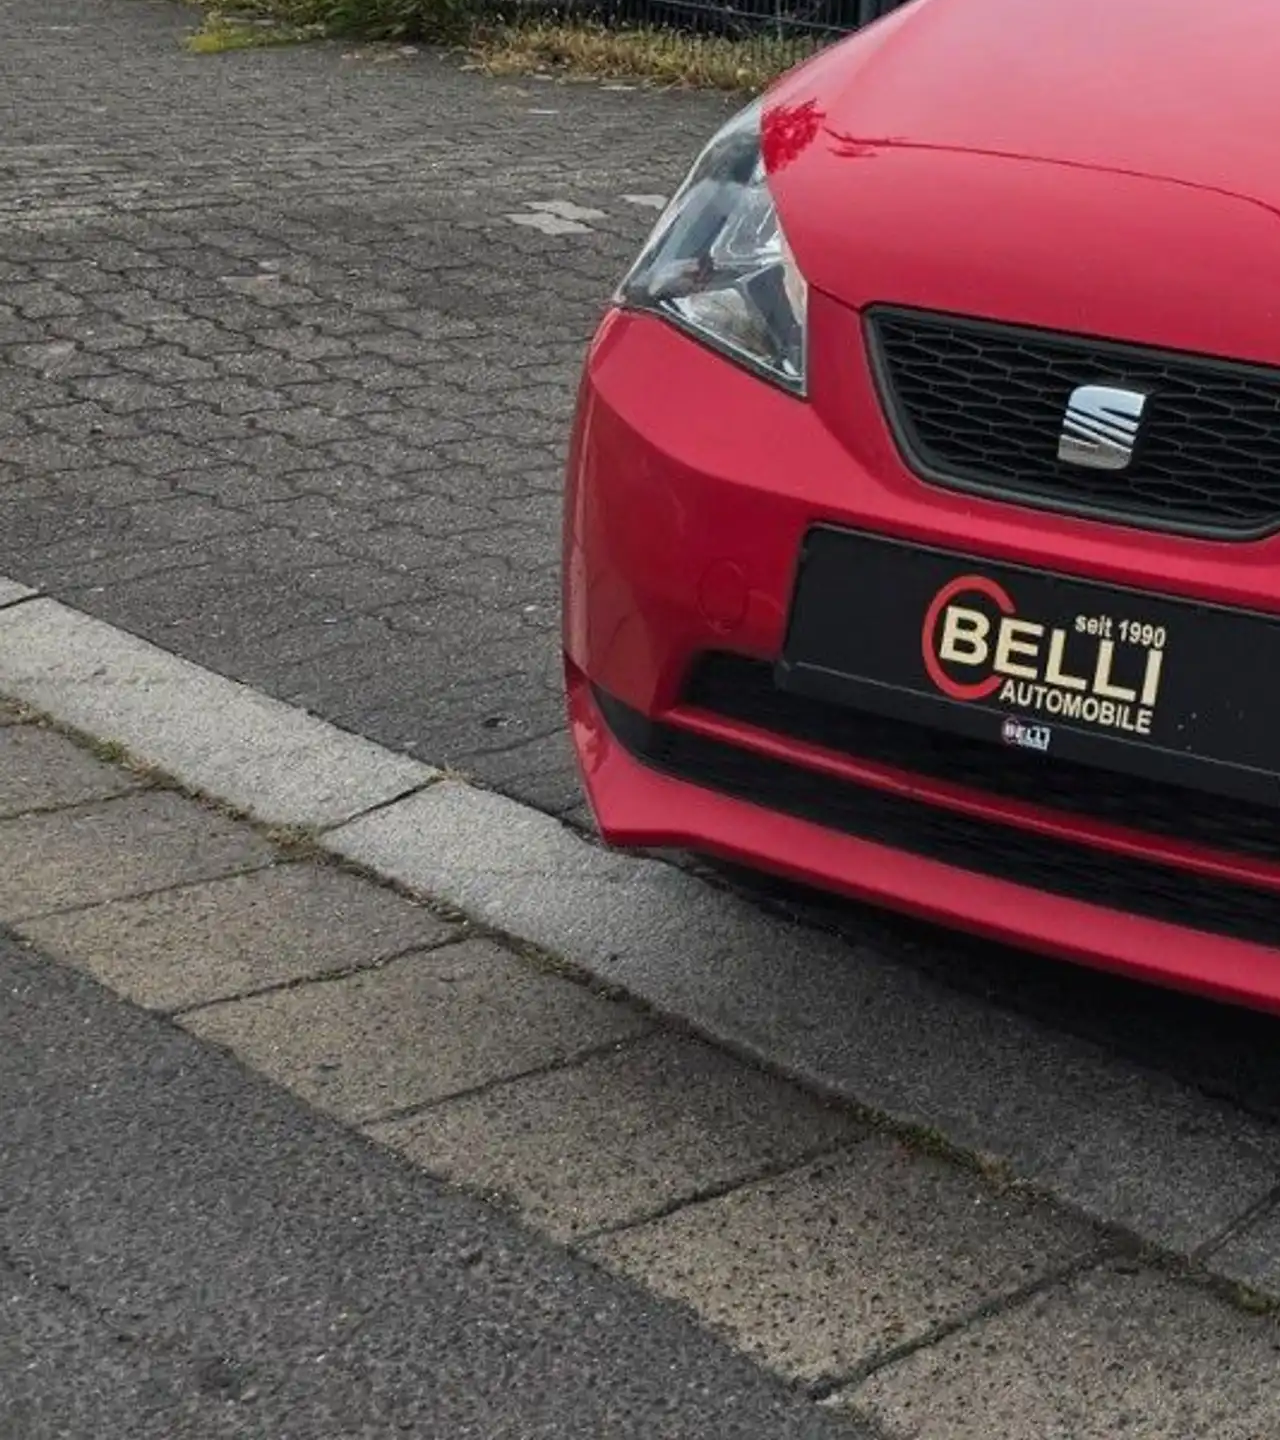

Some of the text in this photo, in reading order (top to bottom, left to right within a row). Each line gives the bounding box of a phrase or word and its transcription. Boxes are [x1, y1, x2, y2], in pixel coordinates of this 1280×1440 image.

[939, 605, 1163, 707] BELLI
[1074, 613, 1166, 648] seit 1990
[999, 679, 1153, 736] AUTOMOBILE
